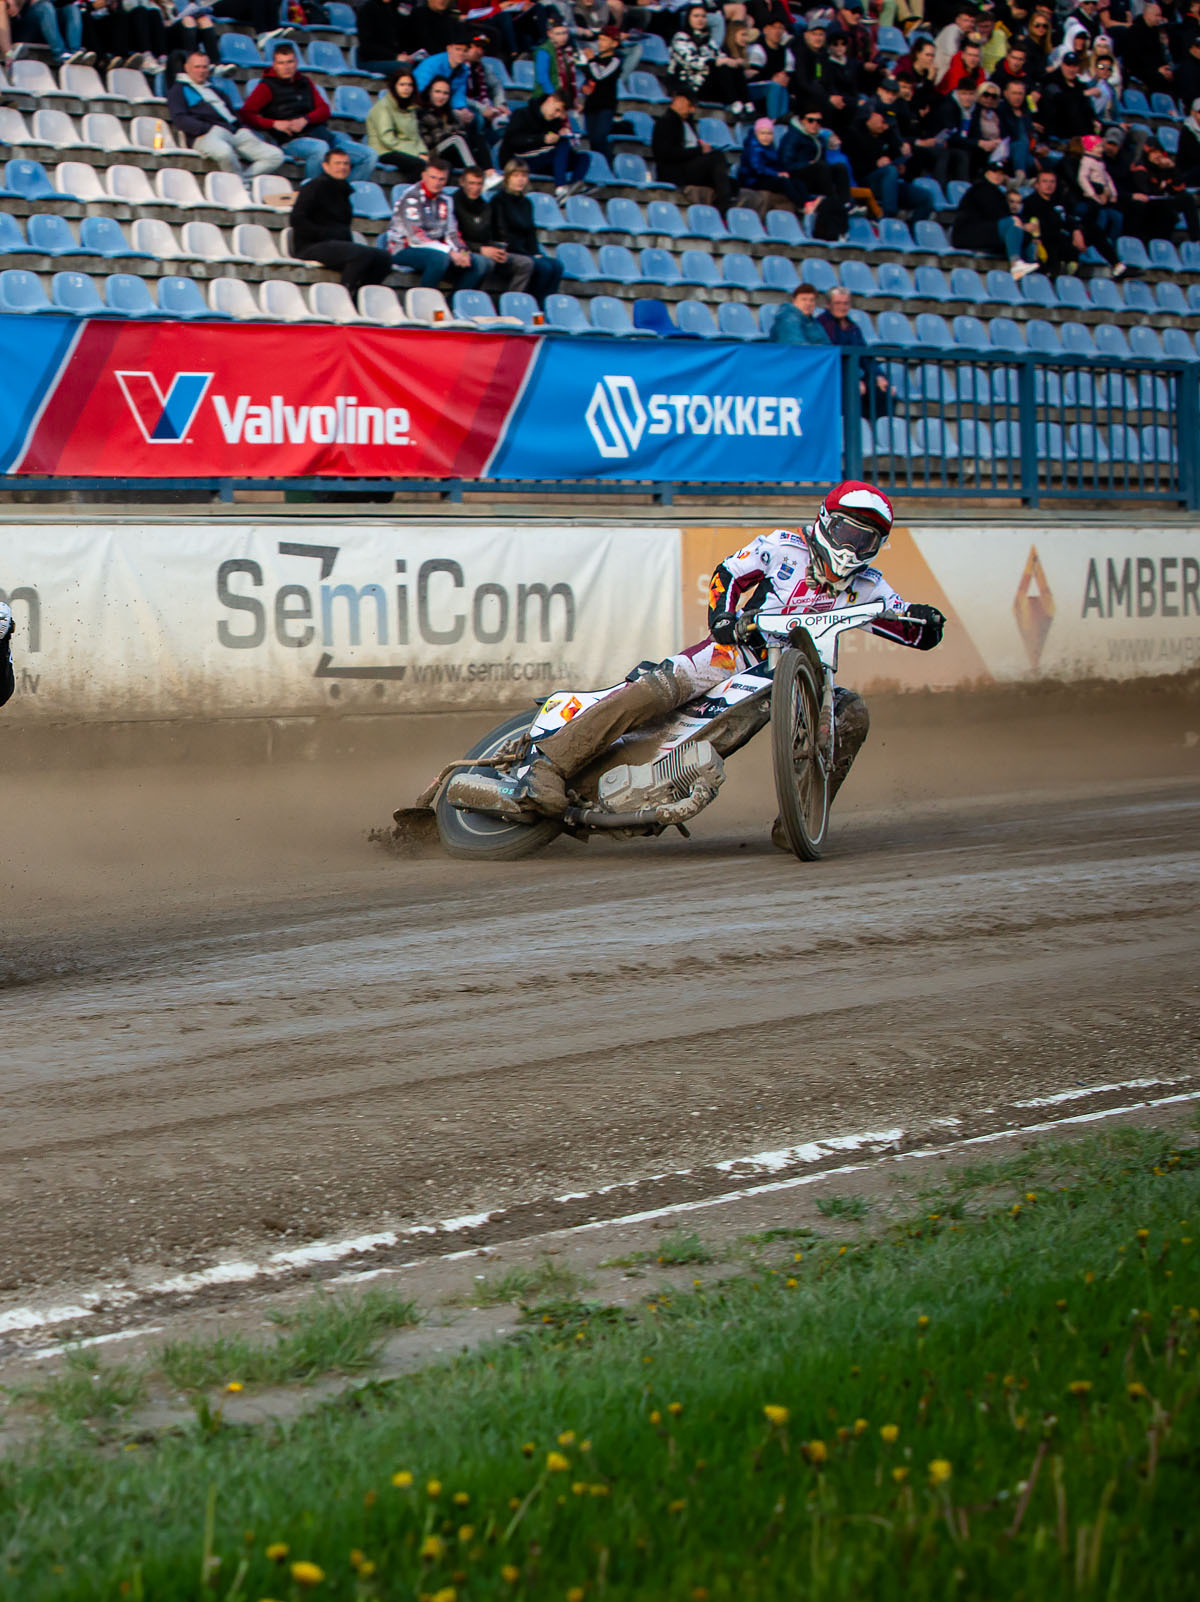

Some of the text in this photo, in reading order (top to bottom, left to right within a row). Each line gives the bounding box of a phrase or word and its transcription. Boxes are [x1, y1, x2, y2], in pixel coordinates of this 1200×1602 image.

[211, 395, 412, 446] Valvoline
[647, 394, 803, 437] STOKKER
[216, 558, 576, 649] SemiCom
[805, 615, 851, 626] OPTIBET
